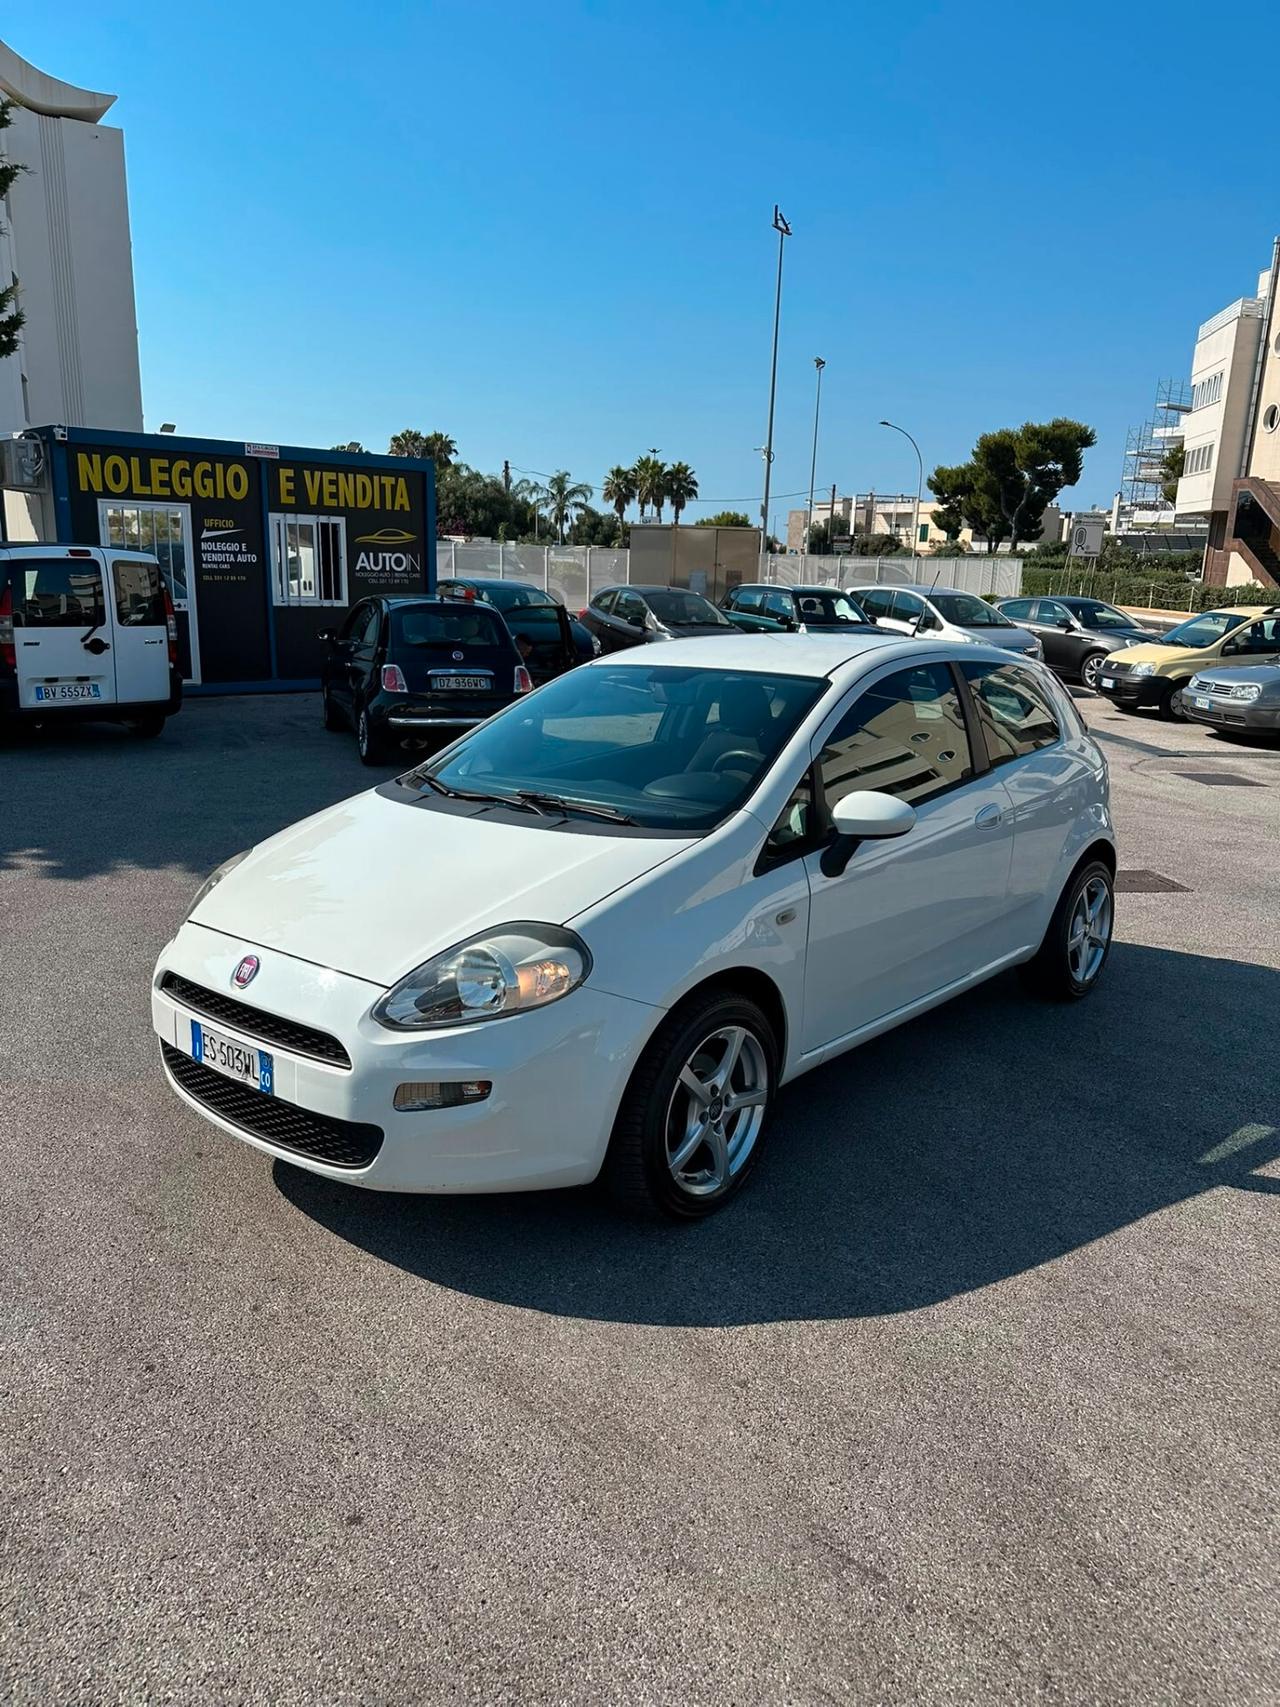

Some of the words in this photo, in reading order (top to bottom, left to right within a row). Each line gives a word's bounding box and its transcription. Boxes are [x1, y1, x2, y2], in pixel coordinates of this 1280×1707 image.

[77, 452, 249, 500] NOLEGGIO
[279, 468, 296, 504] E
[303, 470, 411, 511] VENDITA
[204, 518, 234, 528] UFFICIO
[201, 541, 240, 551] NOLEGGIO
[241, 543, 248, 552] E
[201, 553, 236, 562] VENDITA
[236, 554, 257, 563] AUTO
[439, 678, 452, 688] DZ
[44, 687, 57, 699] BV
[60, 686, 93, 698] 555ZX
[202, 1031, 217, 1061] ES
[219, 1040, 260, 1081] 503WL
[260, 1069, 271, 1088] CO
